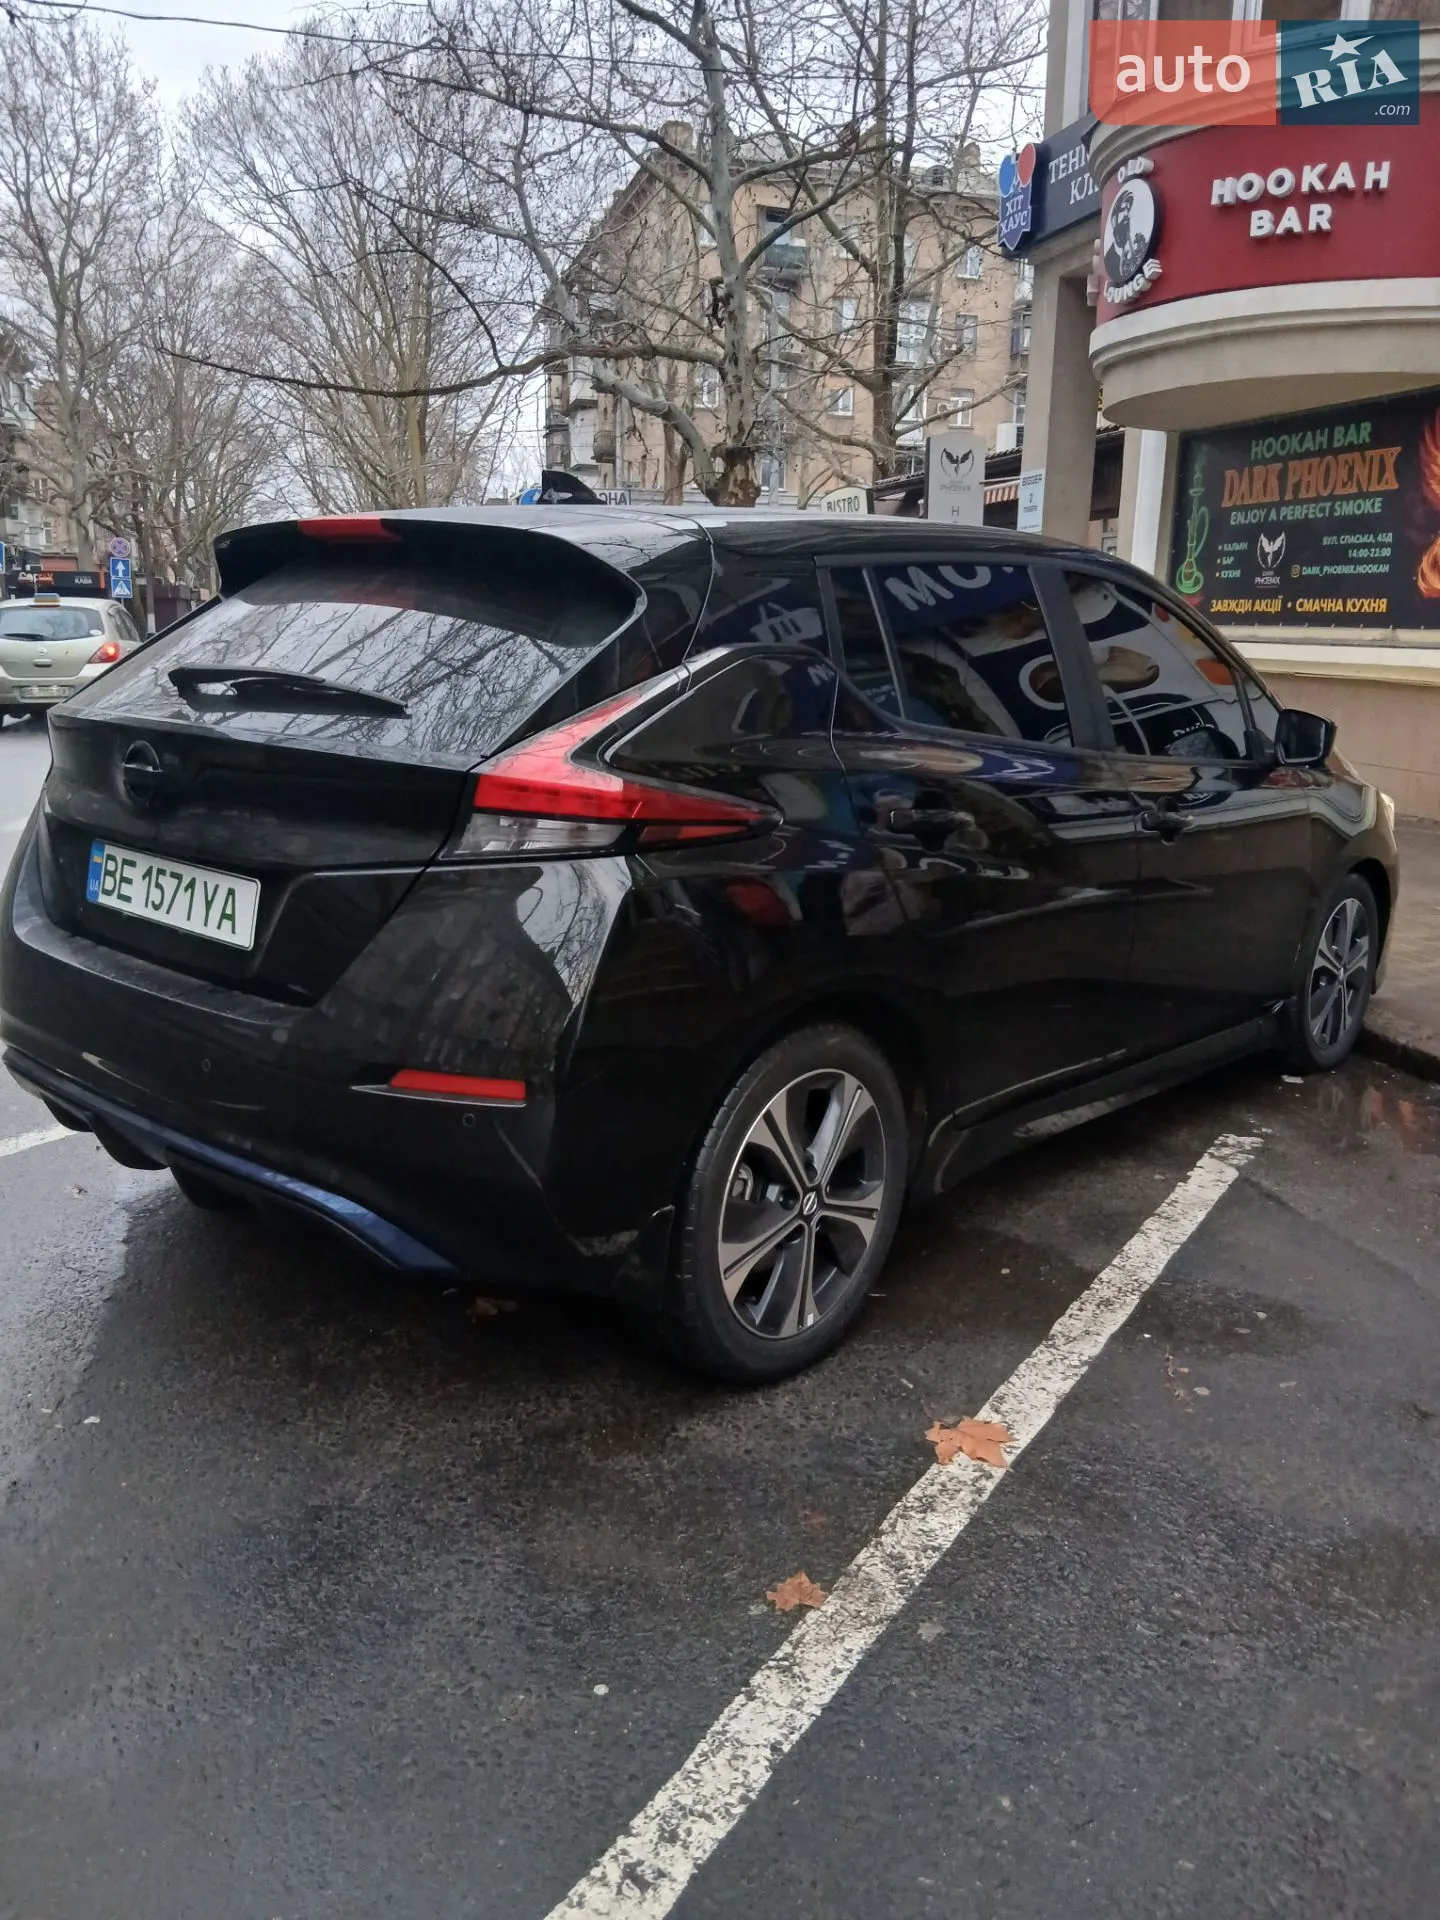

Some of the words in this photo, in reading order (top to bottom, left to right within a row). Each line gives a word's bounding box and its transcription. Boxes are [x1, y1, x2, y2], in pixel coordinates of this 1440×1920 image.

[1117, 156, 1152, 184] OLD
[1210, 160, 1391, 207] HOOKAH
[1069, 172, 1100, 205] КЛ
[1000, 210, 1028, 237] ХАУС
[1249, 203, 1333, 238] BAR
[1103, 258, 1162, 303] LOUNGE
[1250, 428, 1329, 460] HOOKAH
[1333, 421, 1372, 448] BAR
[1221, 463, 1284, 507] DARK
[1285, 446, 1402, 500] PHOENIX
[826, 495, 860, 512] BISTRO
[1230, 508, 1267, 526] ENJOY
[1268, 509, 1277, 522] A
[1279, 502, 1333, 521] PERFECT
[1334, 497, 1384, 516] SMOKE
[1210, 598, 1253, 614] ЗАВЖДИ
[1253, 595, 1284, 614] АКЦІЇ
[1296, 598, 1344, 612] СМАЧНА
[1345, 598, 1388, 613] КУХНЯ
[89, 878, 99, 892] UA
[101, 853, 137, 904] BE
